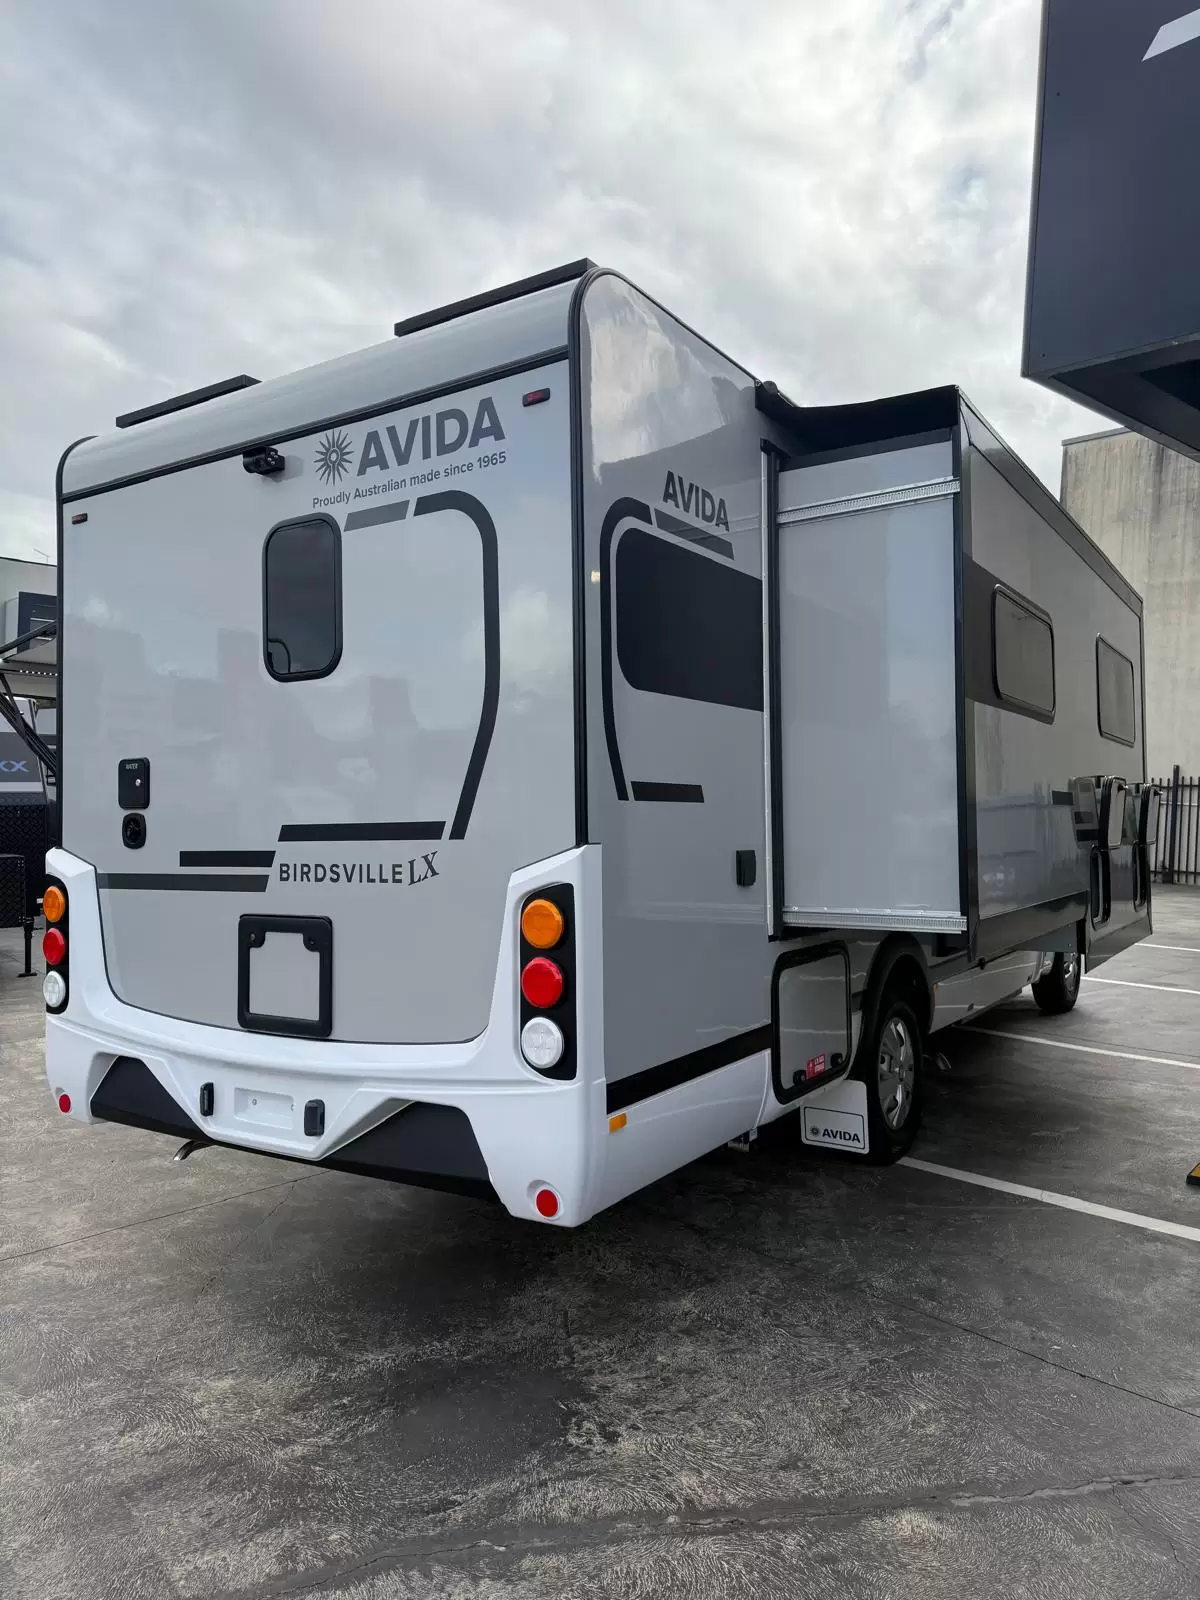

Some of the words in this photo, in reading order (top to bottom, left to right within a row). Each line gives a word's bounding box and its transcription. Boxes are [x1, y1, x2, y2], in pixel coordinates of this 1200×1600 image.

[356, 396, 506, 476] AVIDA
[312, 490, 351, 509] Proudly
[353, 477, 407, 500] Australian
[409, 468, 441, 487] made
[443, 461, 474, 478] since
[477, 451, 507, 469] 1965
[662, 470, 730, 532] AVIDA
[279, 863, 403, 884] BIRDSVILLE
[408, 850, 440, 886] LX
[822, 1128, 861, 1144] AVIDA
